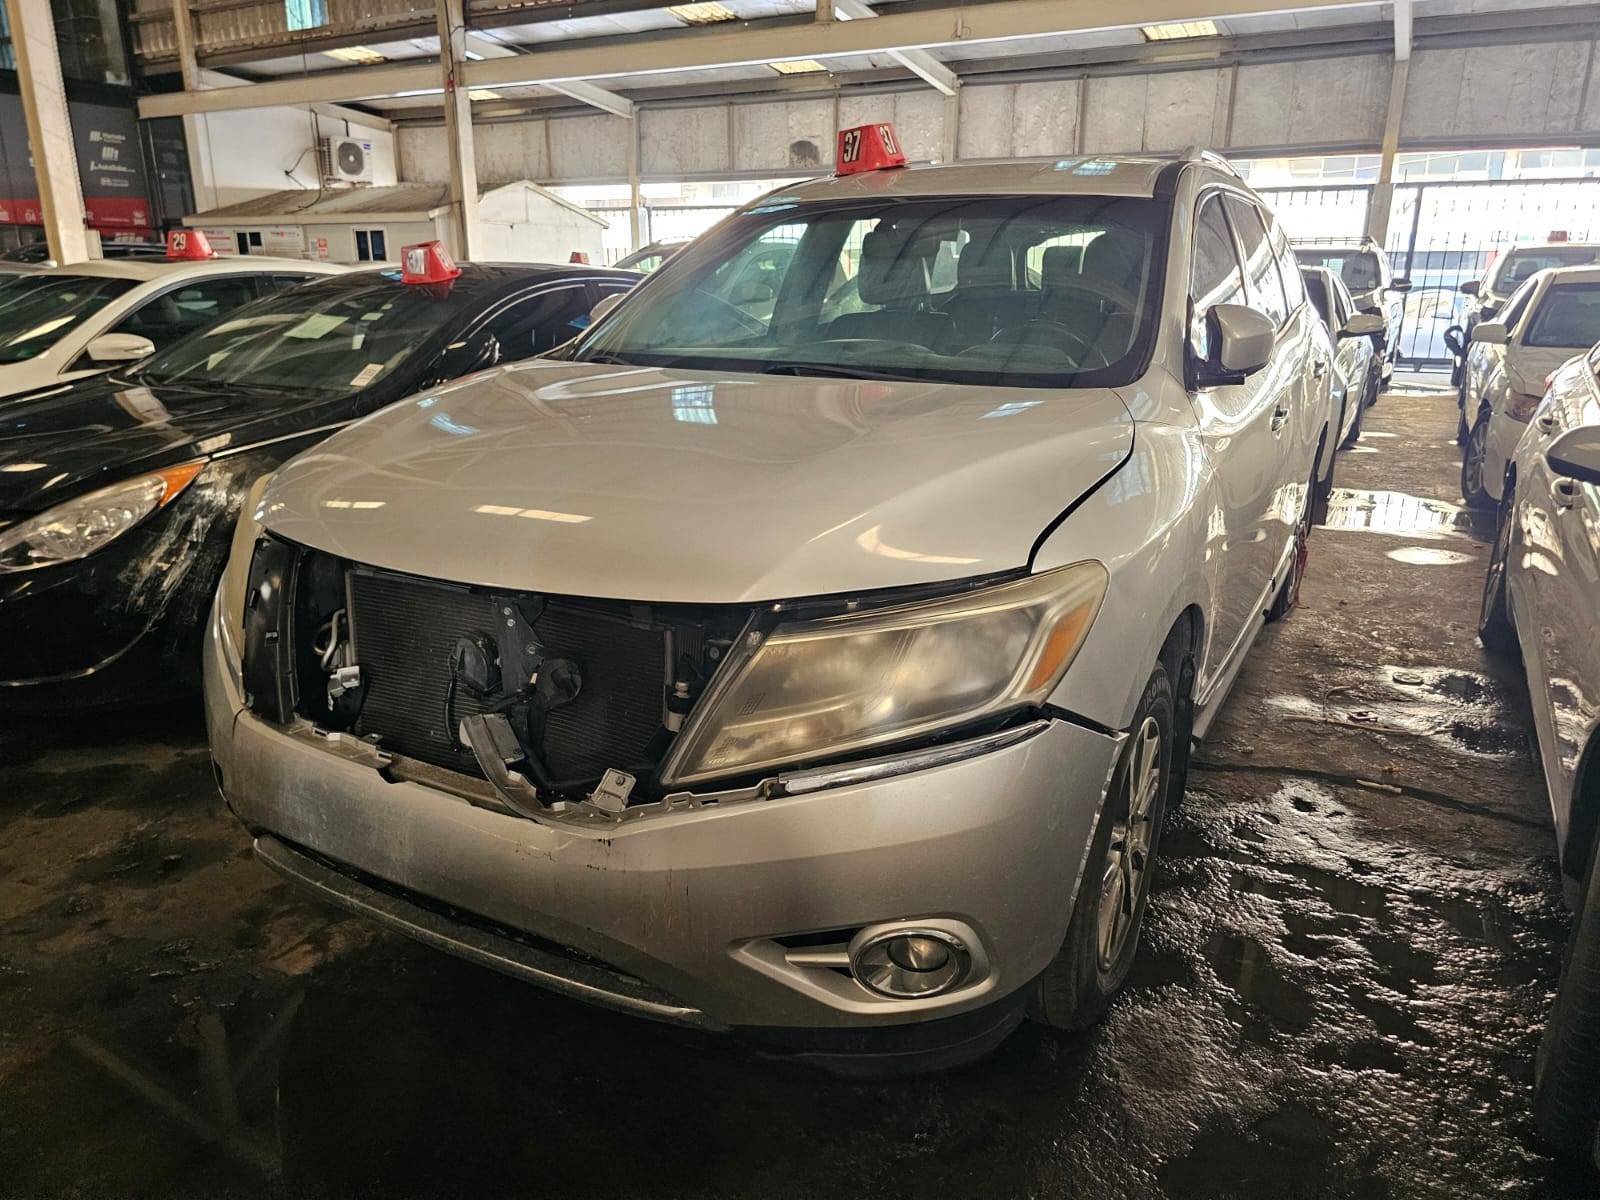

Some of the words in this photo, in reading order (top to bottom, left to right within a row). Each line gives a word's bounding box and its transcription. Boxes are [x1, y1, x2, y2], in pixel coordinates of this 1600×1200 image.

[844, 130, 861, 162] 37
[880, 125, 897, 154] 37
[173, 232, 187, 251] 29
